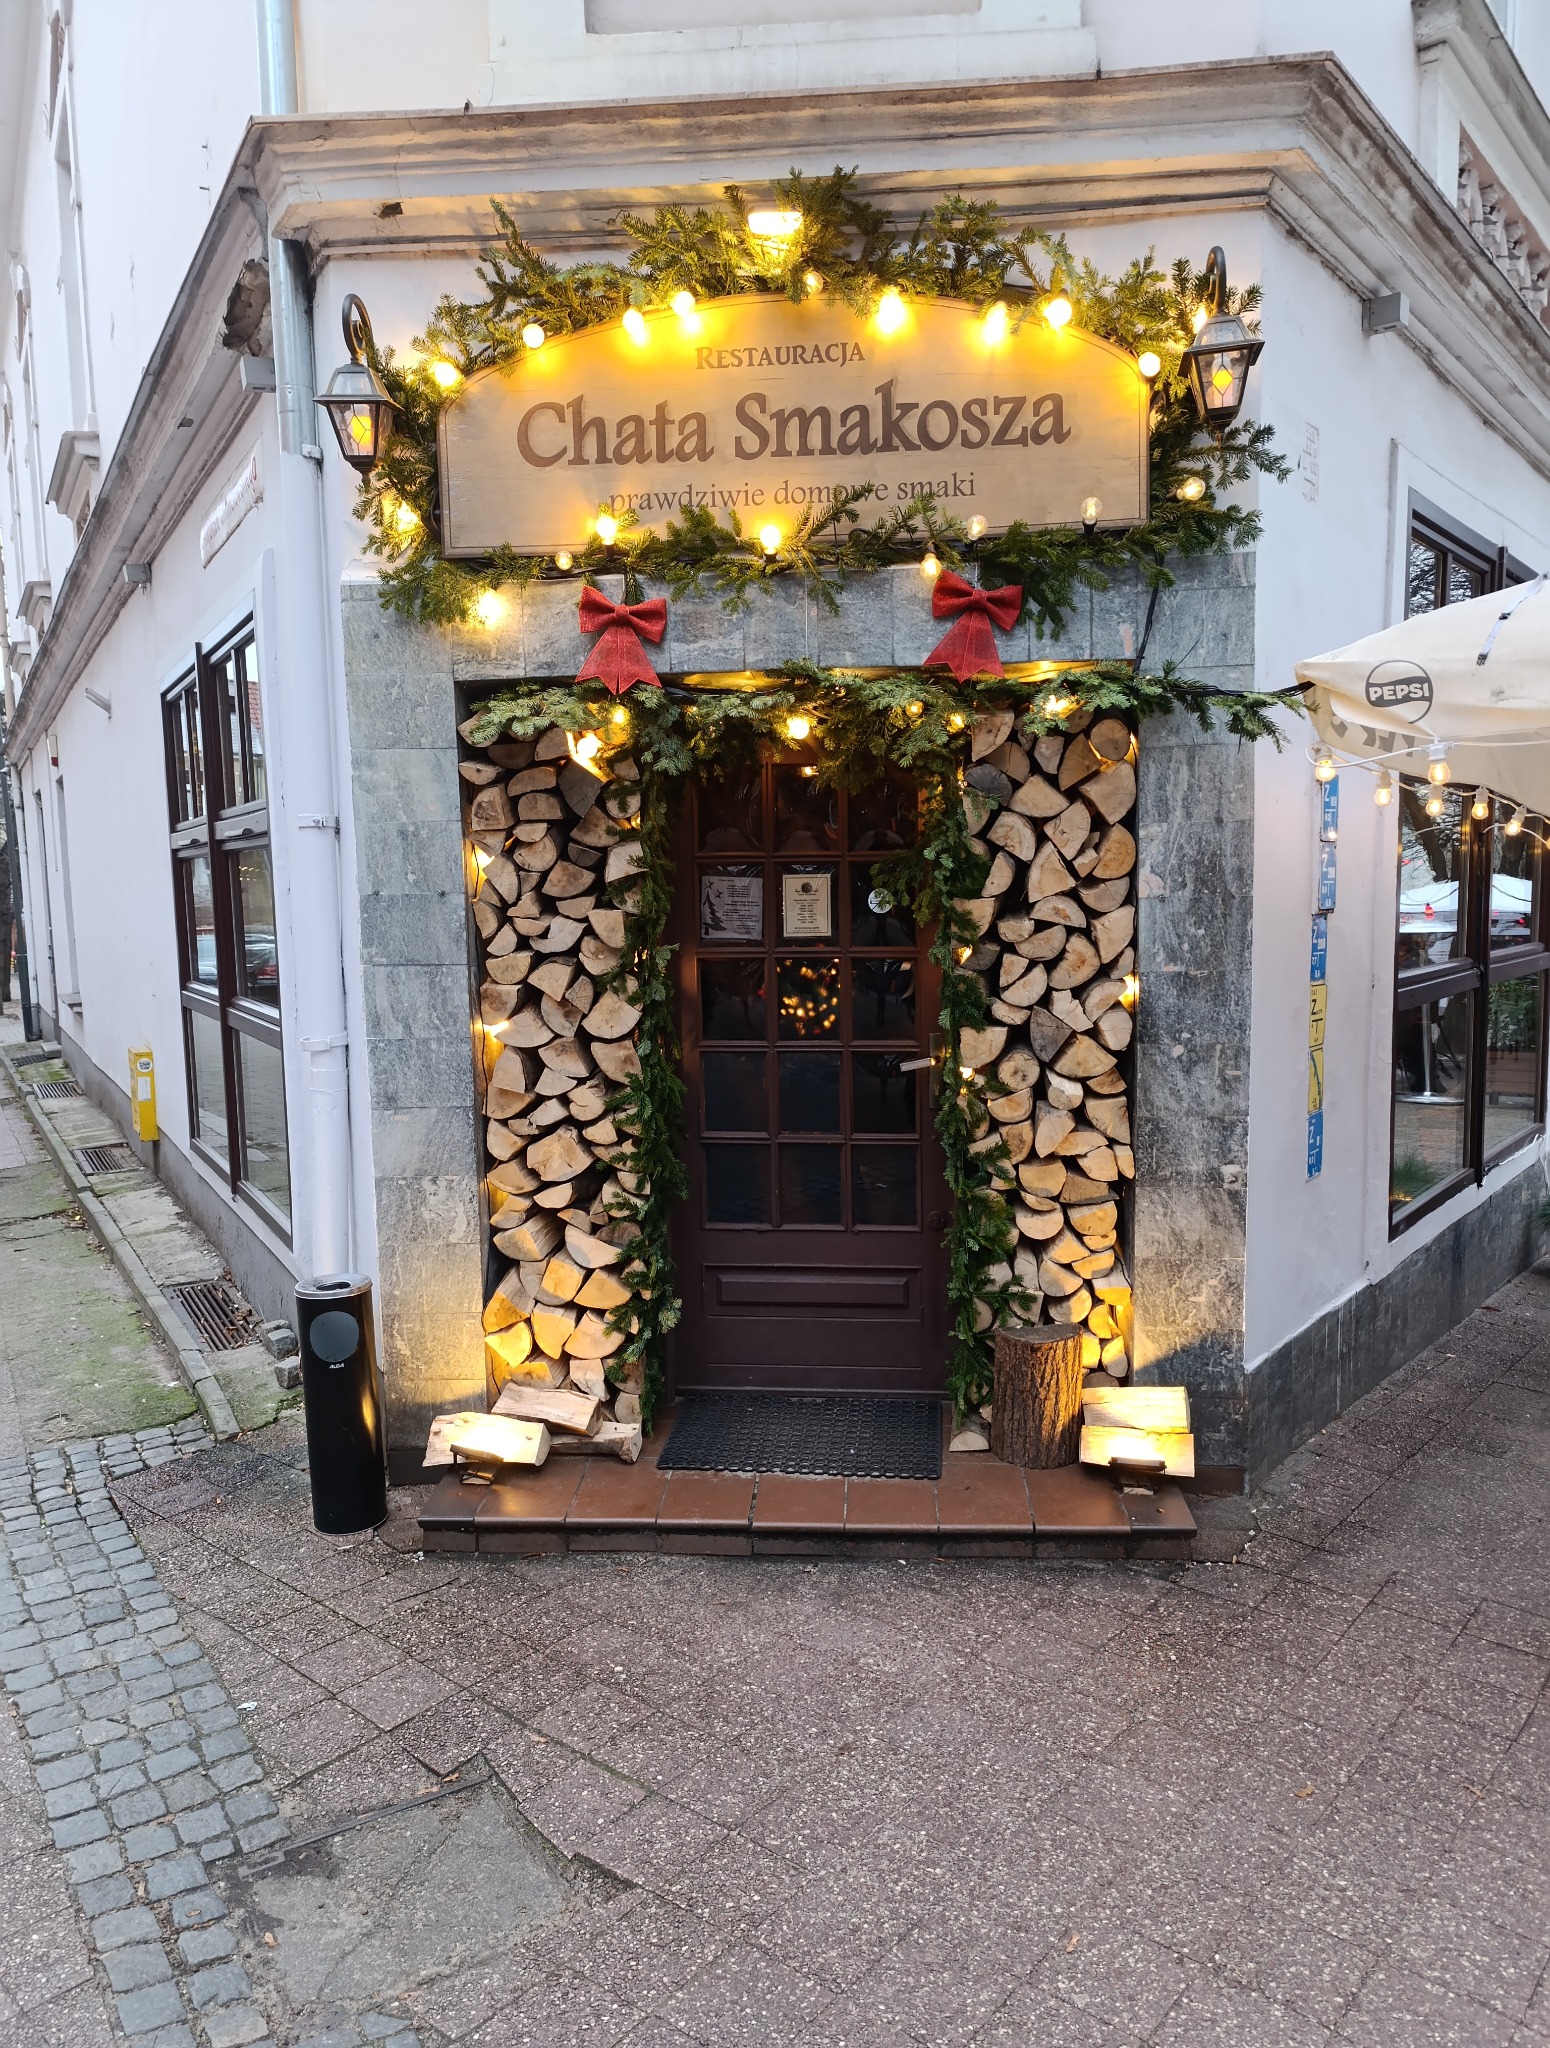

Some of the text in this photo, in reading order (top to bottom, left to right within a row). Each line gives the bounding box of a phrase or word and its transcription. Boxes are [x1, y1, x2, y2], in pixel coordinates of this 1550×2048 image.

[695, 341, 866, 370] RESTAURACJA
[517, 378, 1072, 468] Chata Smakosza
[608, 481, 765, 513] prawdziwie
[897, 471, 977, 502] smaki
[1368, 683, 1430, 701] PEPSI
